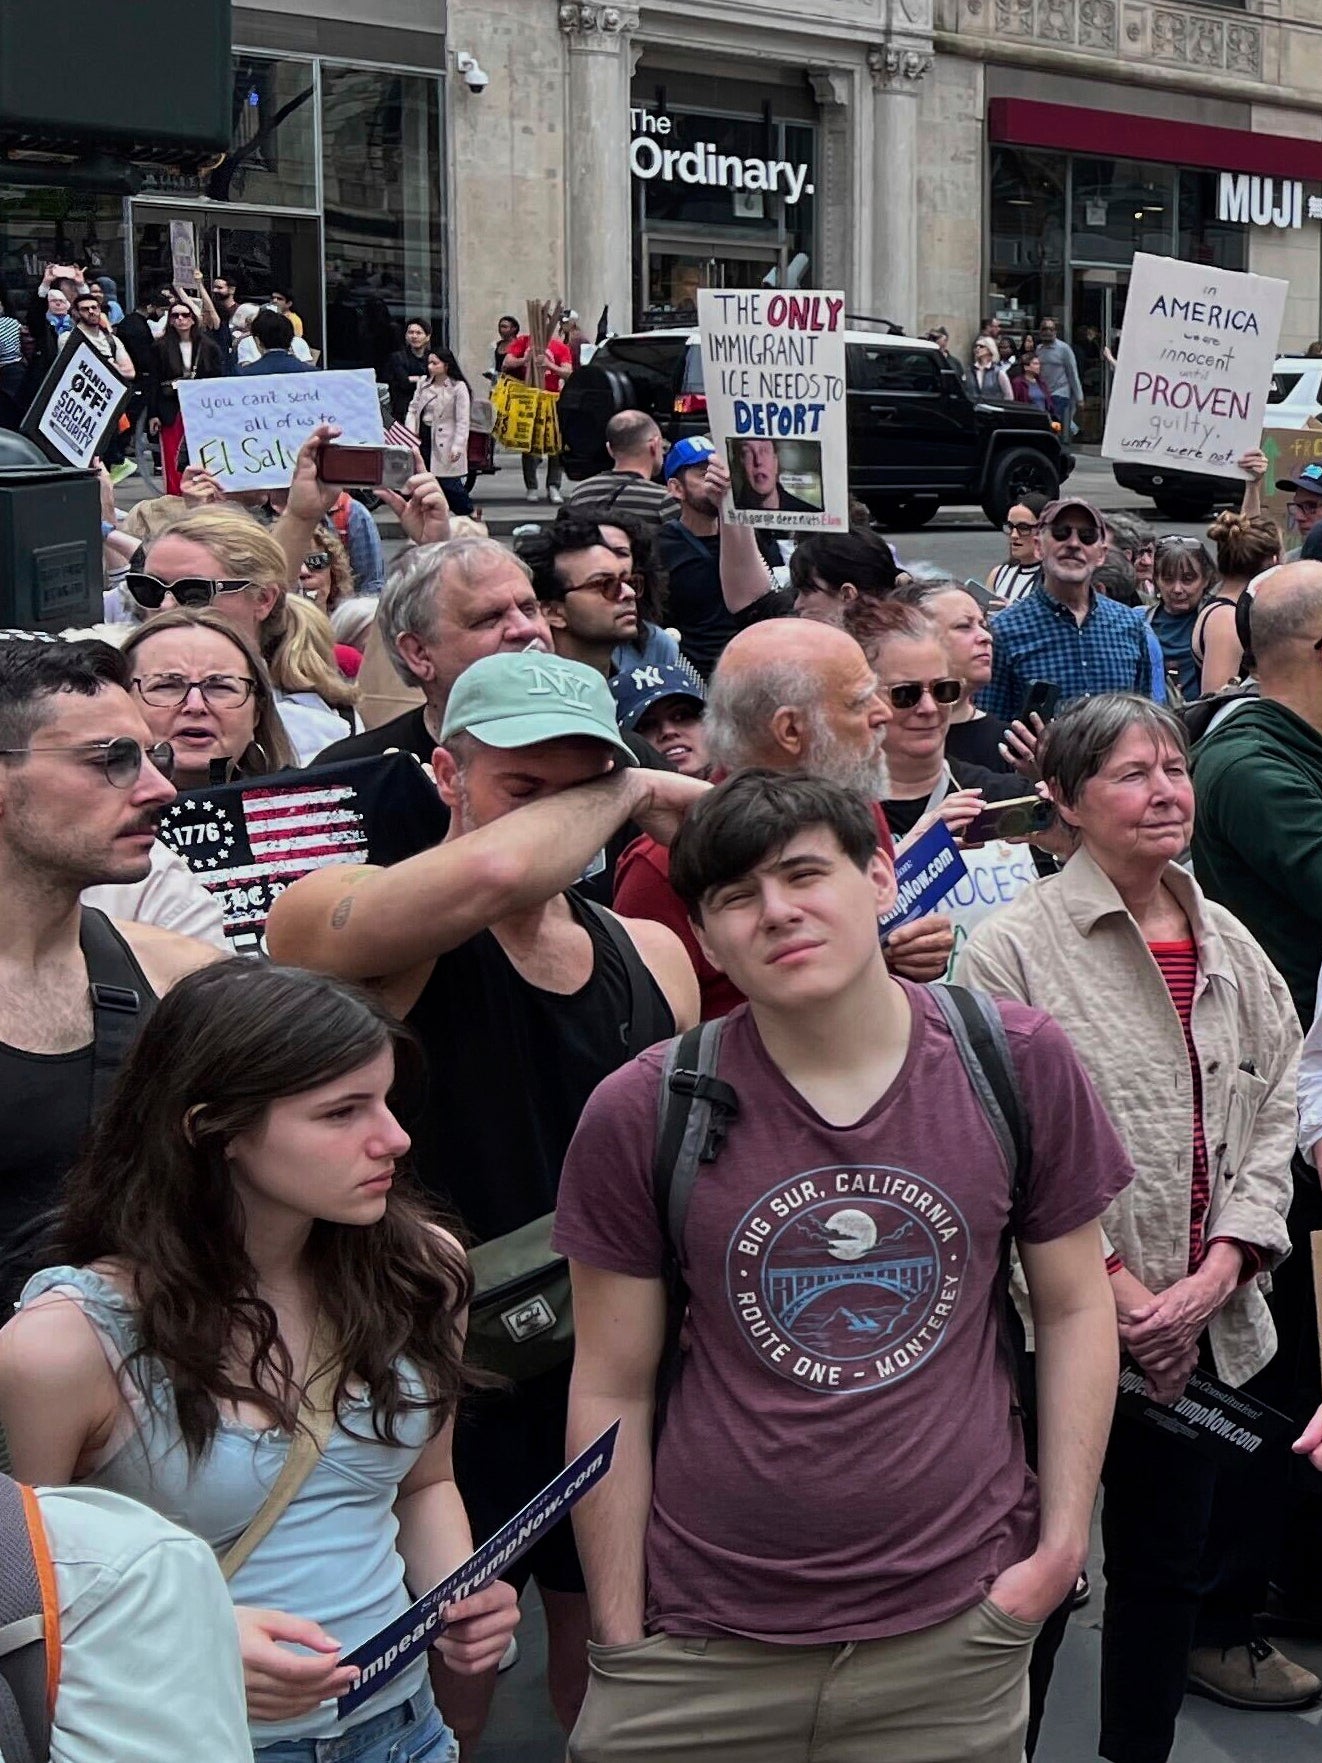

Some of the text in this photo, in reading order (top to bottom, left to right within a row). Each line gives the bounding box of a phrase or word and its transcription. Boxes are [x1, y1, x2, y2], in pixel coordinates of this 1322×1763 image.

[630, 108, 671, 134] The
[630, 136, 815, 204] Ordinary.
[1220, 172, 1303, 229] MUJI
[713, 294, 843, 332] THE ONLY
[1149, 295, 1260, 336] AMERICA
[708, 333, 818, 365] IMMIGRANT
[1160, 346, 1235, 372] innocent
[79, 360, 113, 400] HANDS
[288, 390, 320, 402] send
[721, 370, 843, 401] ICE NEEDS TO
[1132, 371, 1251, 420] PROVEN
[51, 405, 93, 449] SECURITY
[58, 391, 97, 439] SOCIAL
[244, 418, 269, 432] all
[277, 414, 292, 428] of
[734, 400, 825, 436] DEPORT
[199, 439, 235, 477] El
[523, 664, 592, 711] NY
[631, 665, 664, 691] NY
[172, 822, 220, 847] 1776
[738, 1173, 959, 1256] BIG SUR, CALIFORNIA
[737, 1291, 791, 1363] ROUTE
[793, 1356, 842, 1386] ONE
[875, 1274, 959, 1378] MONTEREY
